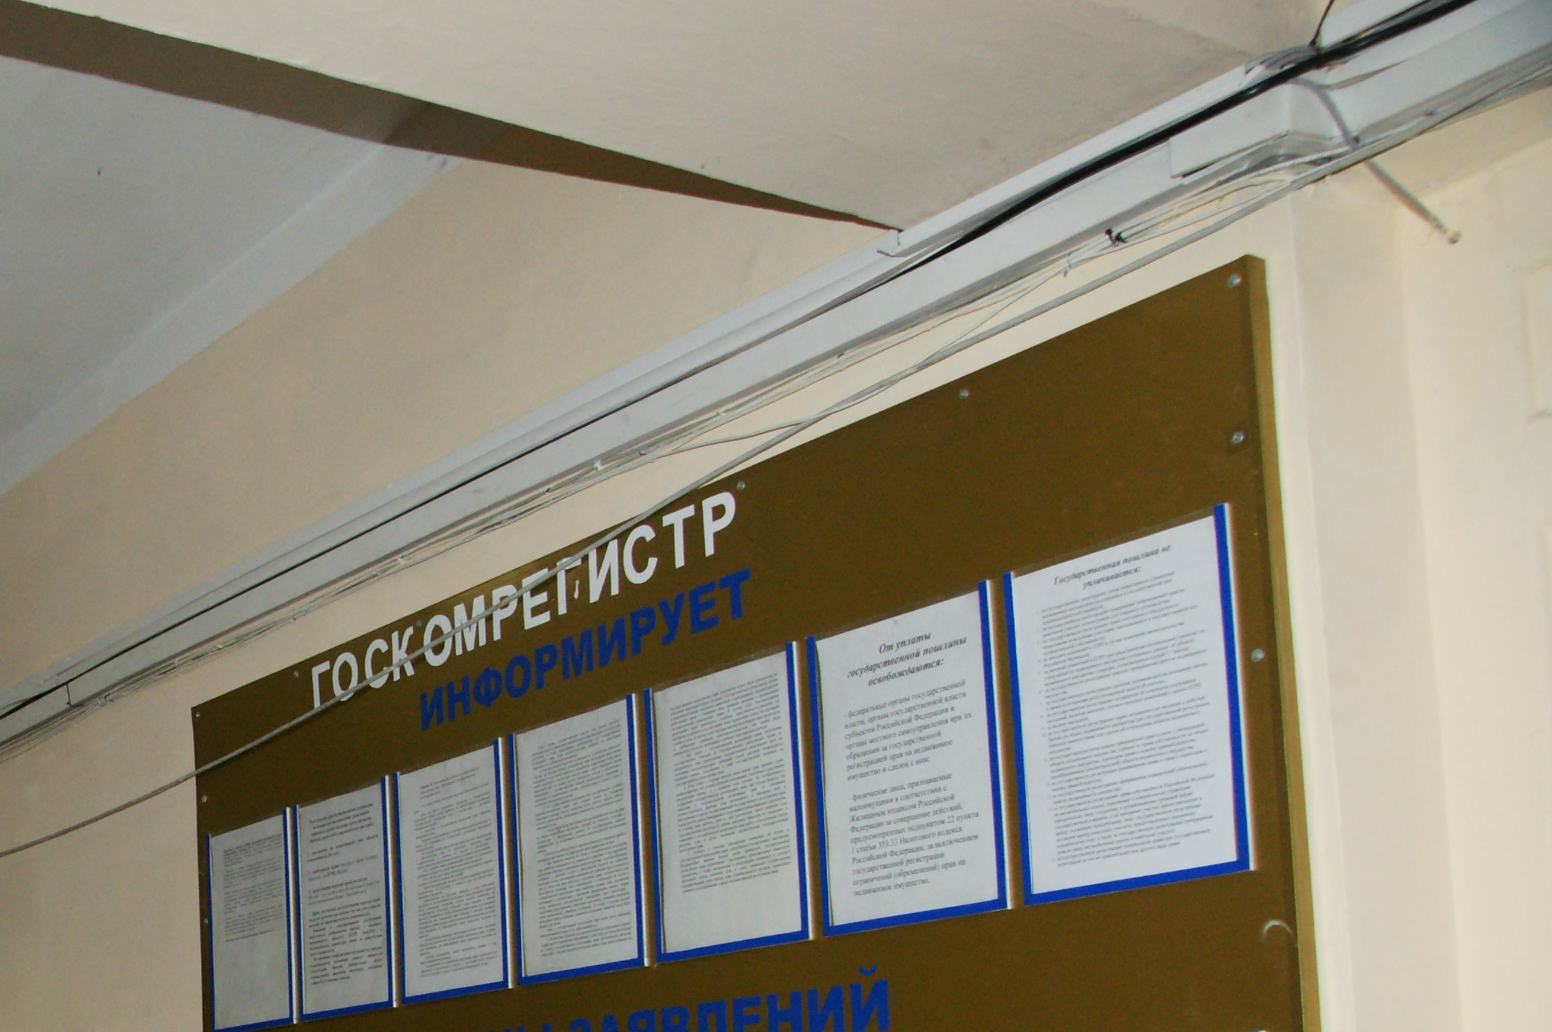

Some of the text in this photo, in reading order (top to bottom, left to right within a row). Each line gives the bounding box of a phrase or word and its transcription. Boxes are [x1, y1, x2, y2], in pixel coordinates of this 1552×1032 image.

[1054, 559, 1121, 585] Государственная
[1161, 544, 1171, 552] не
[1082, 566, 1141, 590] уплачивается:
[311, 491, 737, 709] ГОСКОМРЕГИСТР
[421, 569, 751, 732] ИНФОРМИРУЕТ
[846, 636, 967, 677] государственной пошлины
[878, 632, 931, 654] От уплаты
[867, 657, 944, 686] освобождаются:
